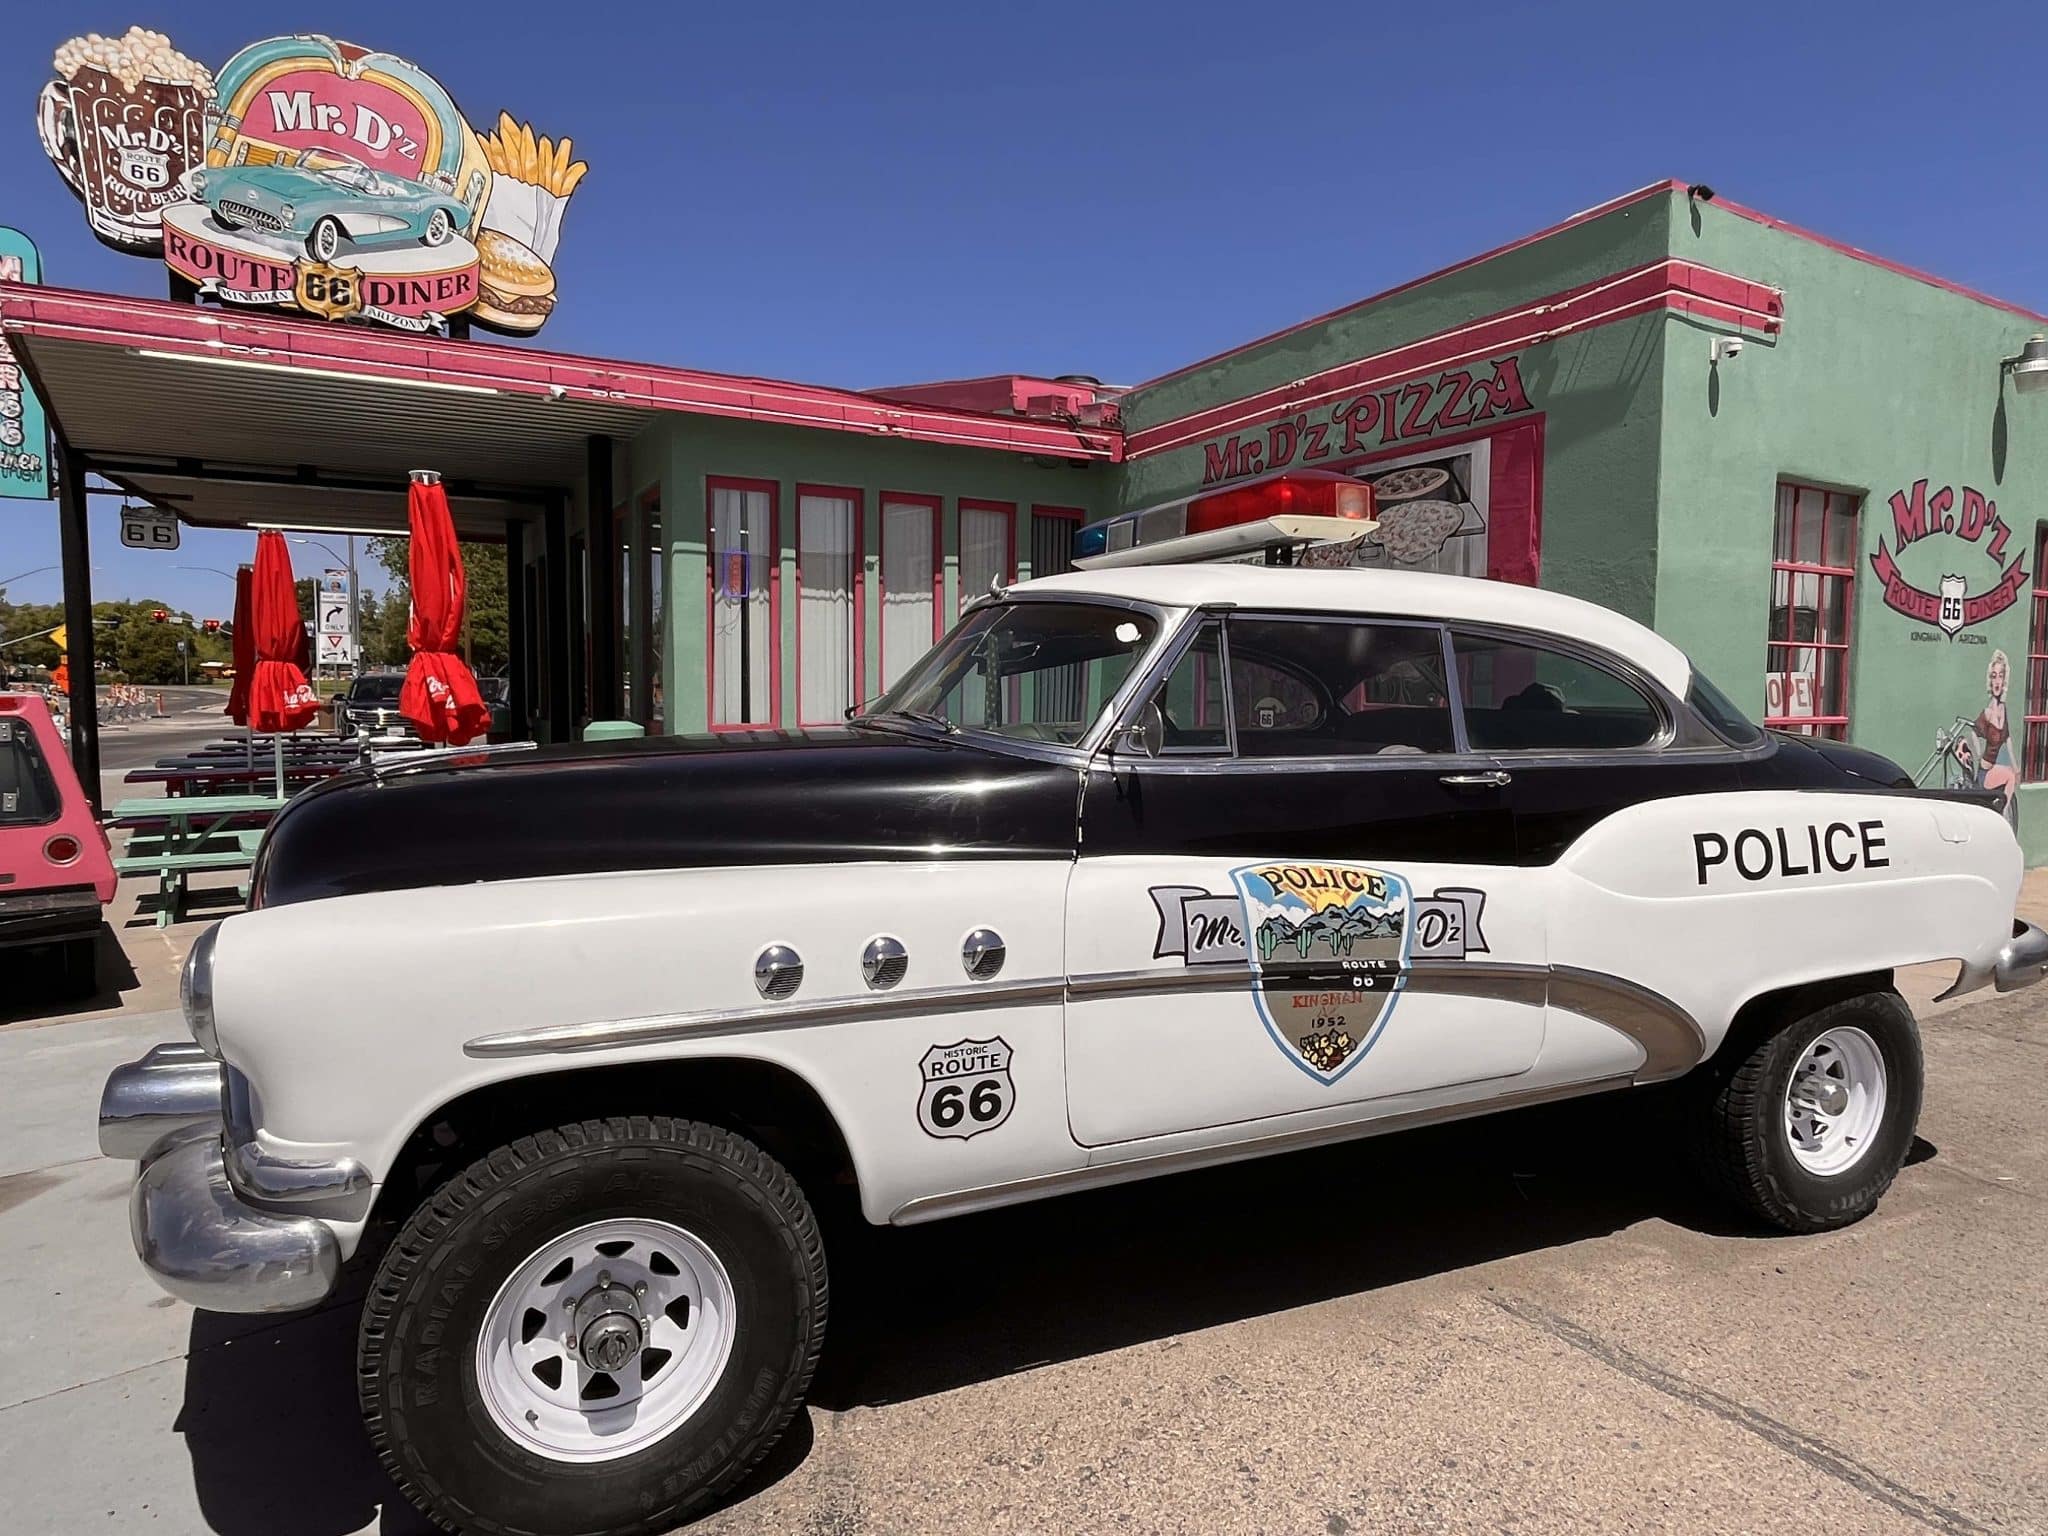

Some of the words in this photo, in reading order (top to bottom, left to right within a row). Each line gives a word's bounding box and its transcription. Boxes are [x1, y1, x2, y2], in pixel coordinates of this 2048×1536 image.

[100, 124, 147, 149] Mr.
[149, 126, 184, 155] D'z
[265, 89, 347, 135] Mr.
[351, 102, 420, 160] D'z
[126, 152, 162, 164] ROUTE
[131, 164, 160, 182] 66
[105, 174, 147, 201] ROOT
[150, 184, 188, 205] BEER
[168, 231, 291, 290] ROUTE
[305, 272, 351, 306] 66
[369, 273, 472, 306] DINER
[221, 287, 289, 303] KINGMAN
[367, 308, 428, 331] ARIZONA
[1202, 435, 1264, 485] Mr.
[1266, 413, 1330, 470] D'z
[1332, 355, 1534, 454] PIZZA
[126, 523, 173, 543] 66
[1888, 478, 1954, 556] Mr.
[1956, 485, 2012, 569] D'z
[1890, 580, 1934, 617] ROUTE
[1942, 597, 1961, 620] 66
[1968, 586, 2012, 620] DINER
[324, 623, 345, 631] ONLY
[1910, 631, 1942, 642] KINGMAN
[1958, 633, 1988, 645] ARIZONA
[1692, 819, 1890, 886] POLICE
[1259, 864, 1389, 901] POLICE
[1190, 912, 1247, 950] Mr.
[1417, 907, 1461, 949] D'z
[1342, 960, 1387, 970] ROUTE
[1352, 975, 1374, 987] 66
[1292, 990, 1362, 1008] KINGMAN
[1311, 1015, 1347, 1029] 1952
[931, 1052, 1001, 1077] ROUTE
[944, 1045, 988, 1059] HISTORIC
[930, 1079, 1002, 1128] 66
[415, 1259, 480, 1408] RADIAL
